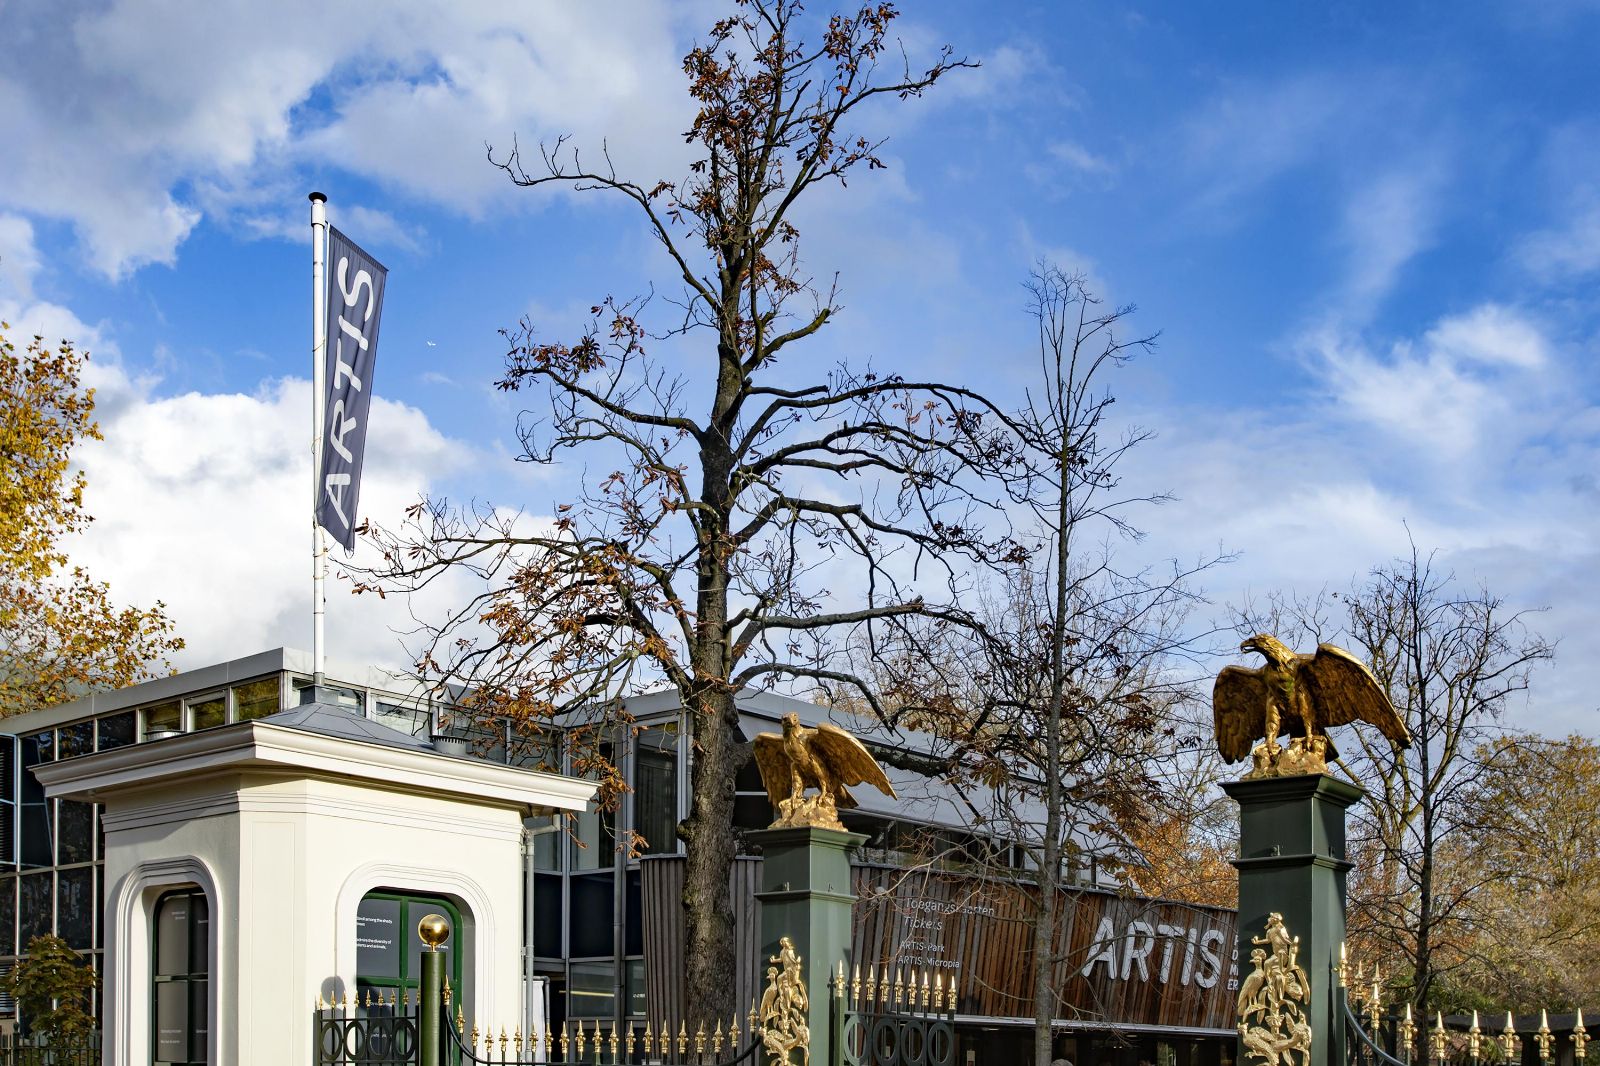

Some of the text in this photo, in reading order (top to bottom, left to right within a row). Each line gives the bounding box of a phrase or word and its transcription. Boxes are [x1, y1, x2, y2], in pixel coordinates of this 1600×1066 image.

[325, 257, 373, 529] ARTIS
[897, 955, 961, 970] ARTIS-Micropia
[1081, 916, 1225, 988] ARTIS
